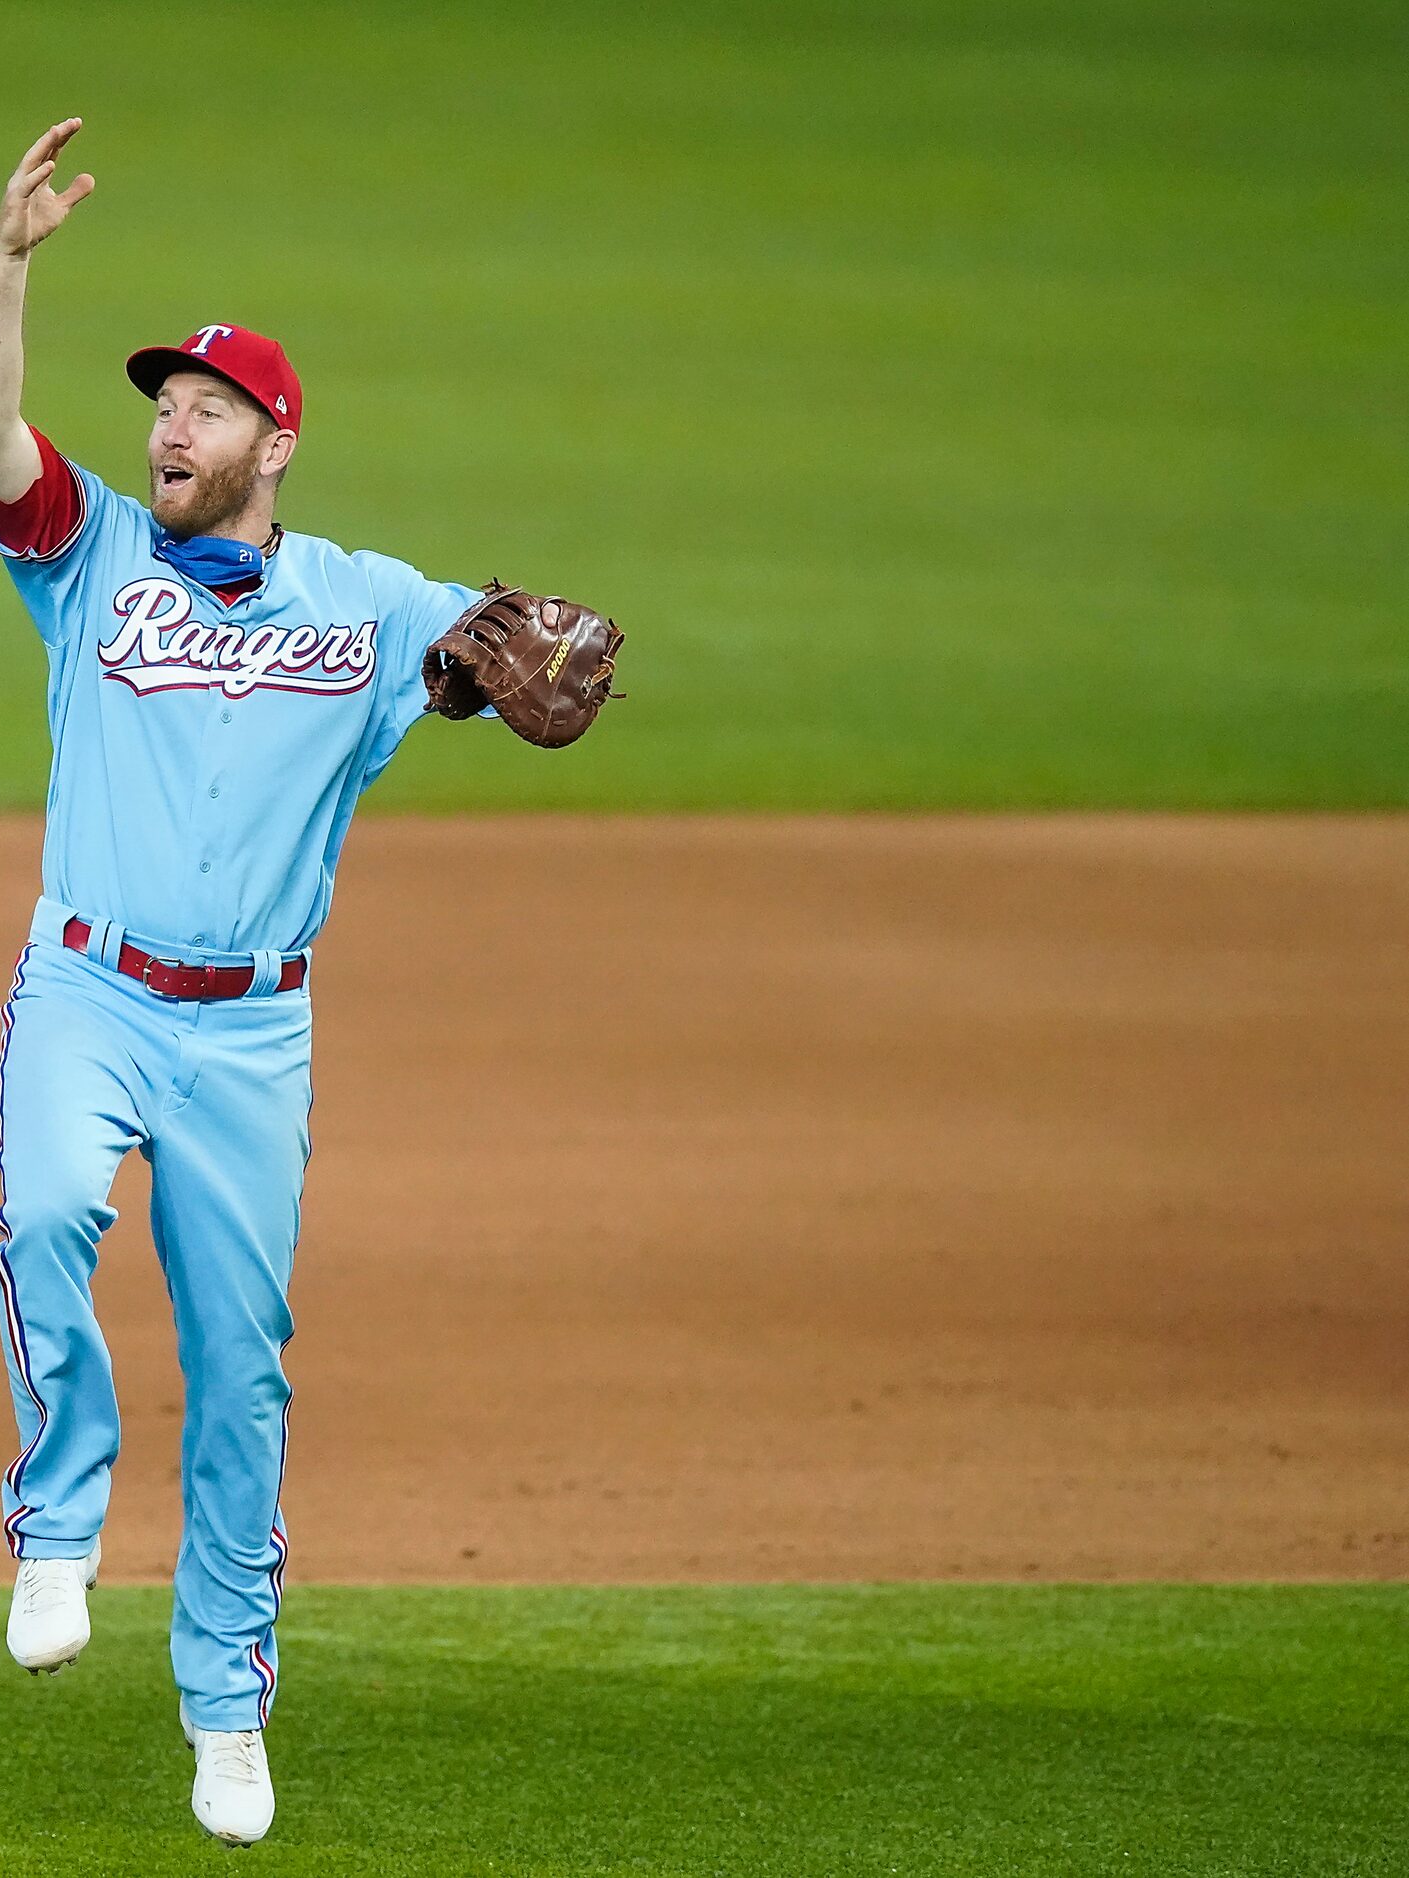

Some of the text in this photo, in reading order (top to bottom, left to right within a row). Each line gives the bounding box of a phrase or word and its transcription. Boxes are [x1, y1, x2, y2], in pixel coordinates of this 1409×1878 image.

[190, 324, 234, 357] T
[239, 549, 253, 562] 21
[97, 577, 378, 699] Rangers
[546, 638, 571, 684] A2000
